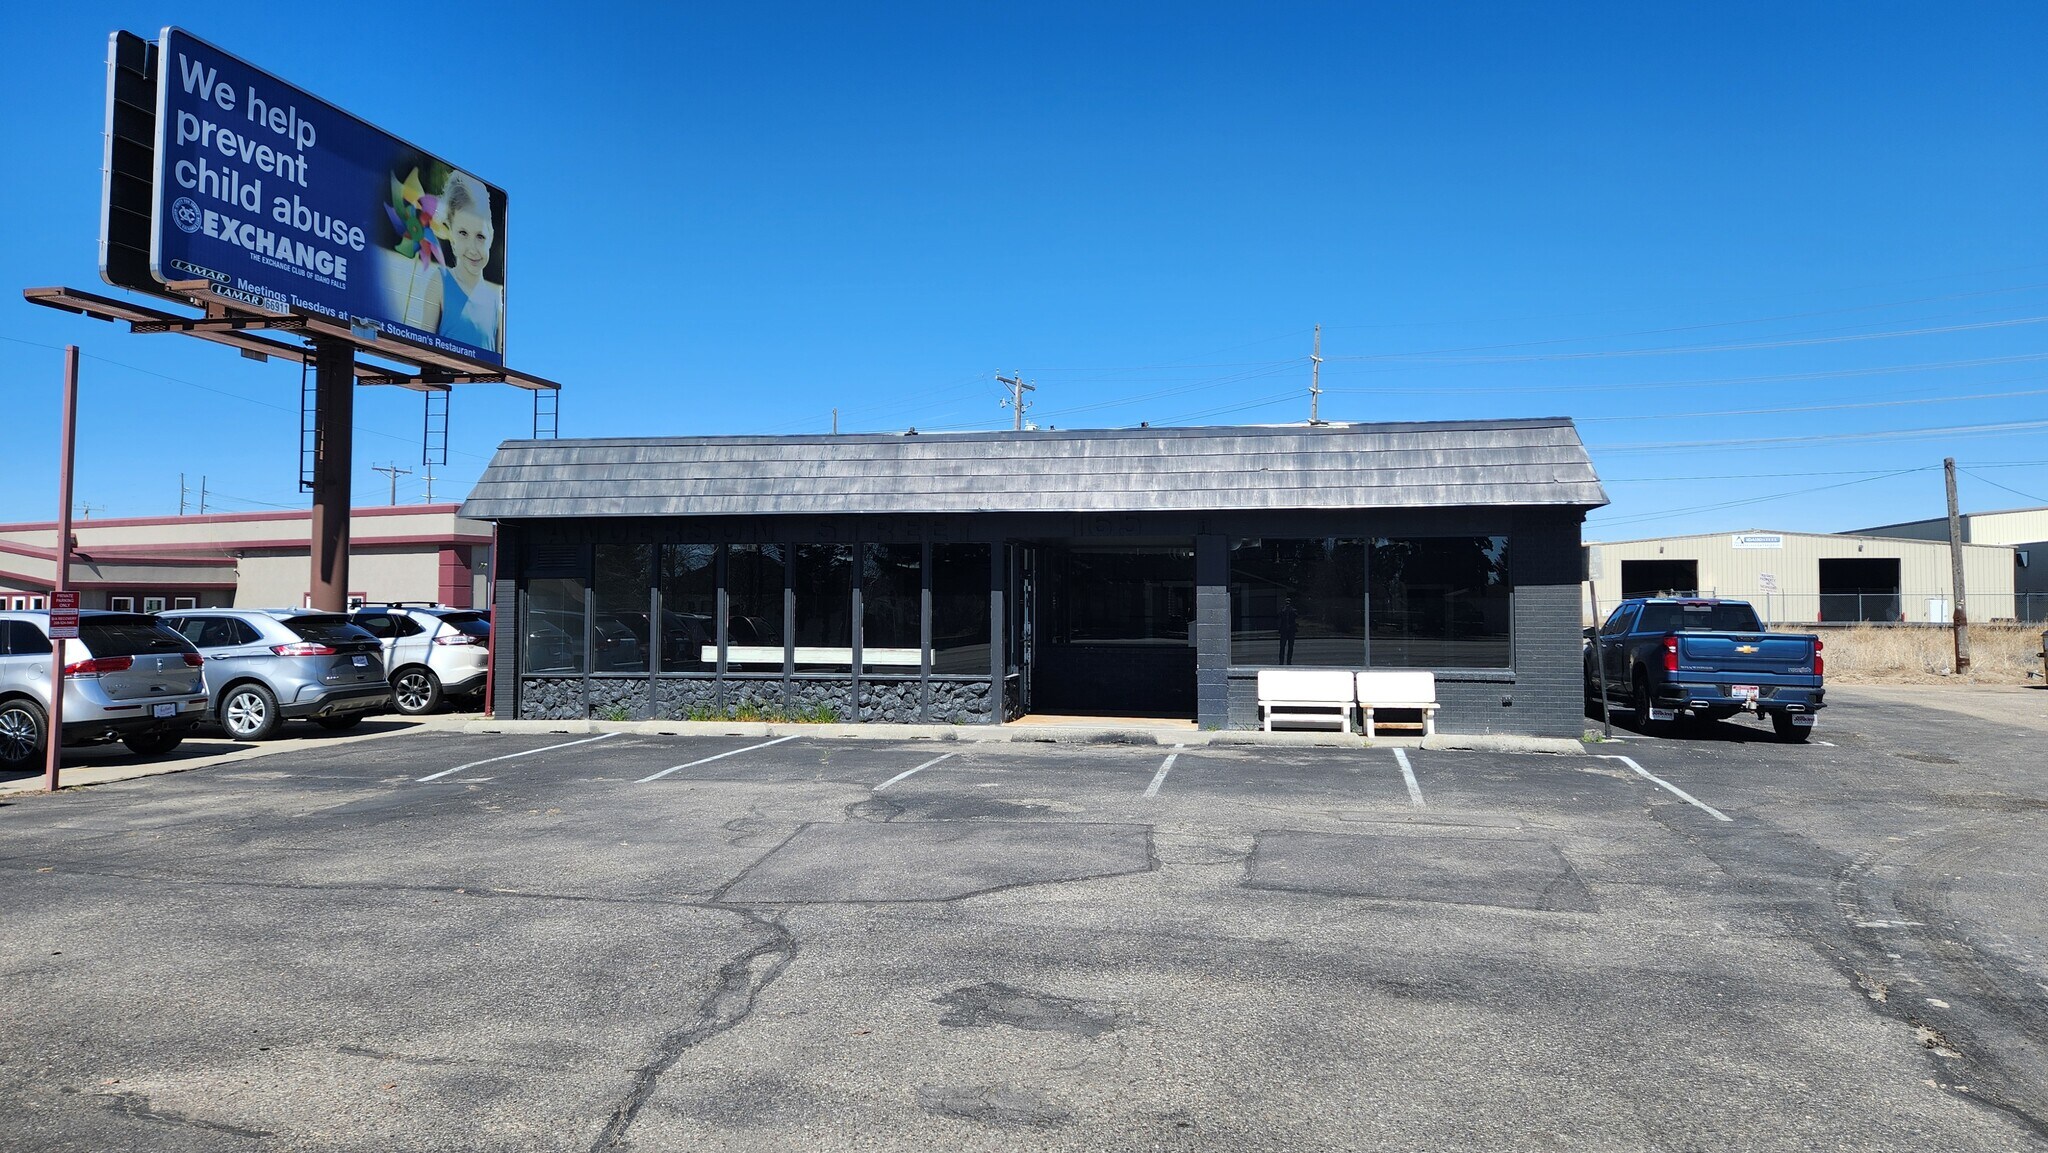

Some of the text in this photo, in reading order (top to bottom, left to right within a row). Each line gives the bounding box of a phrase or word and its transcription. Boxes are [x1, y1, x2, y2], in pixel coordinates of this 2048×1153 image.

[179, 53, 316, 151] We help
[177, 109, 308, 188] prevent
[175, 157, 366, 251] child abuse
[175, 260, 226, 283] LAMAR
[203, 208, 347, 282] EXCHANGE
[250, 252, 261, 263] THE
[261, 257, 291, 272] EXCHANGE
[291, 266, 306, 277] CLUB
[306, 270, 314, 279] OF
[330, 279, 347, 290] FALLS
[216, 284, 260, 306] LAMAR
[237, 277, 288, 303] Meetings
[290, 293, 336, 317] Tuesdays
[338, 310, 348, 321] at
[386, 323, 434, 346] Stockman's
[434, 337, 476, 359] Restaurant
[265, 298, 289, 314] 66911
[817, 515, 977, 542] STREET
